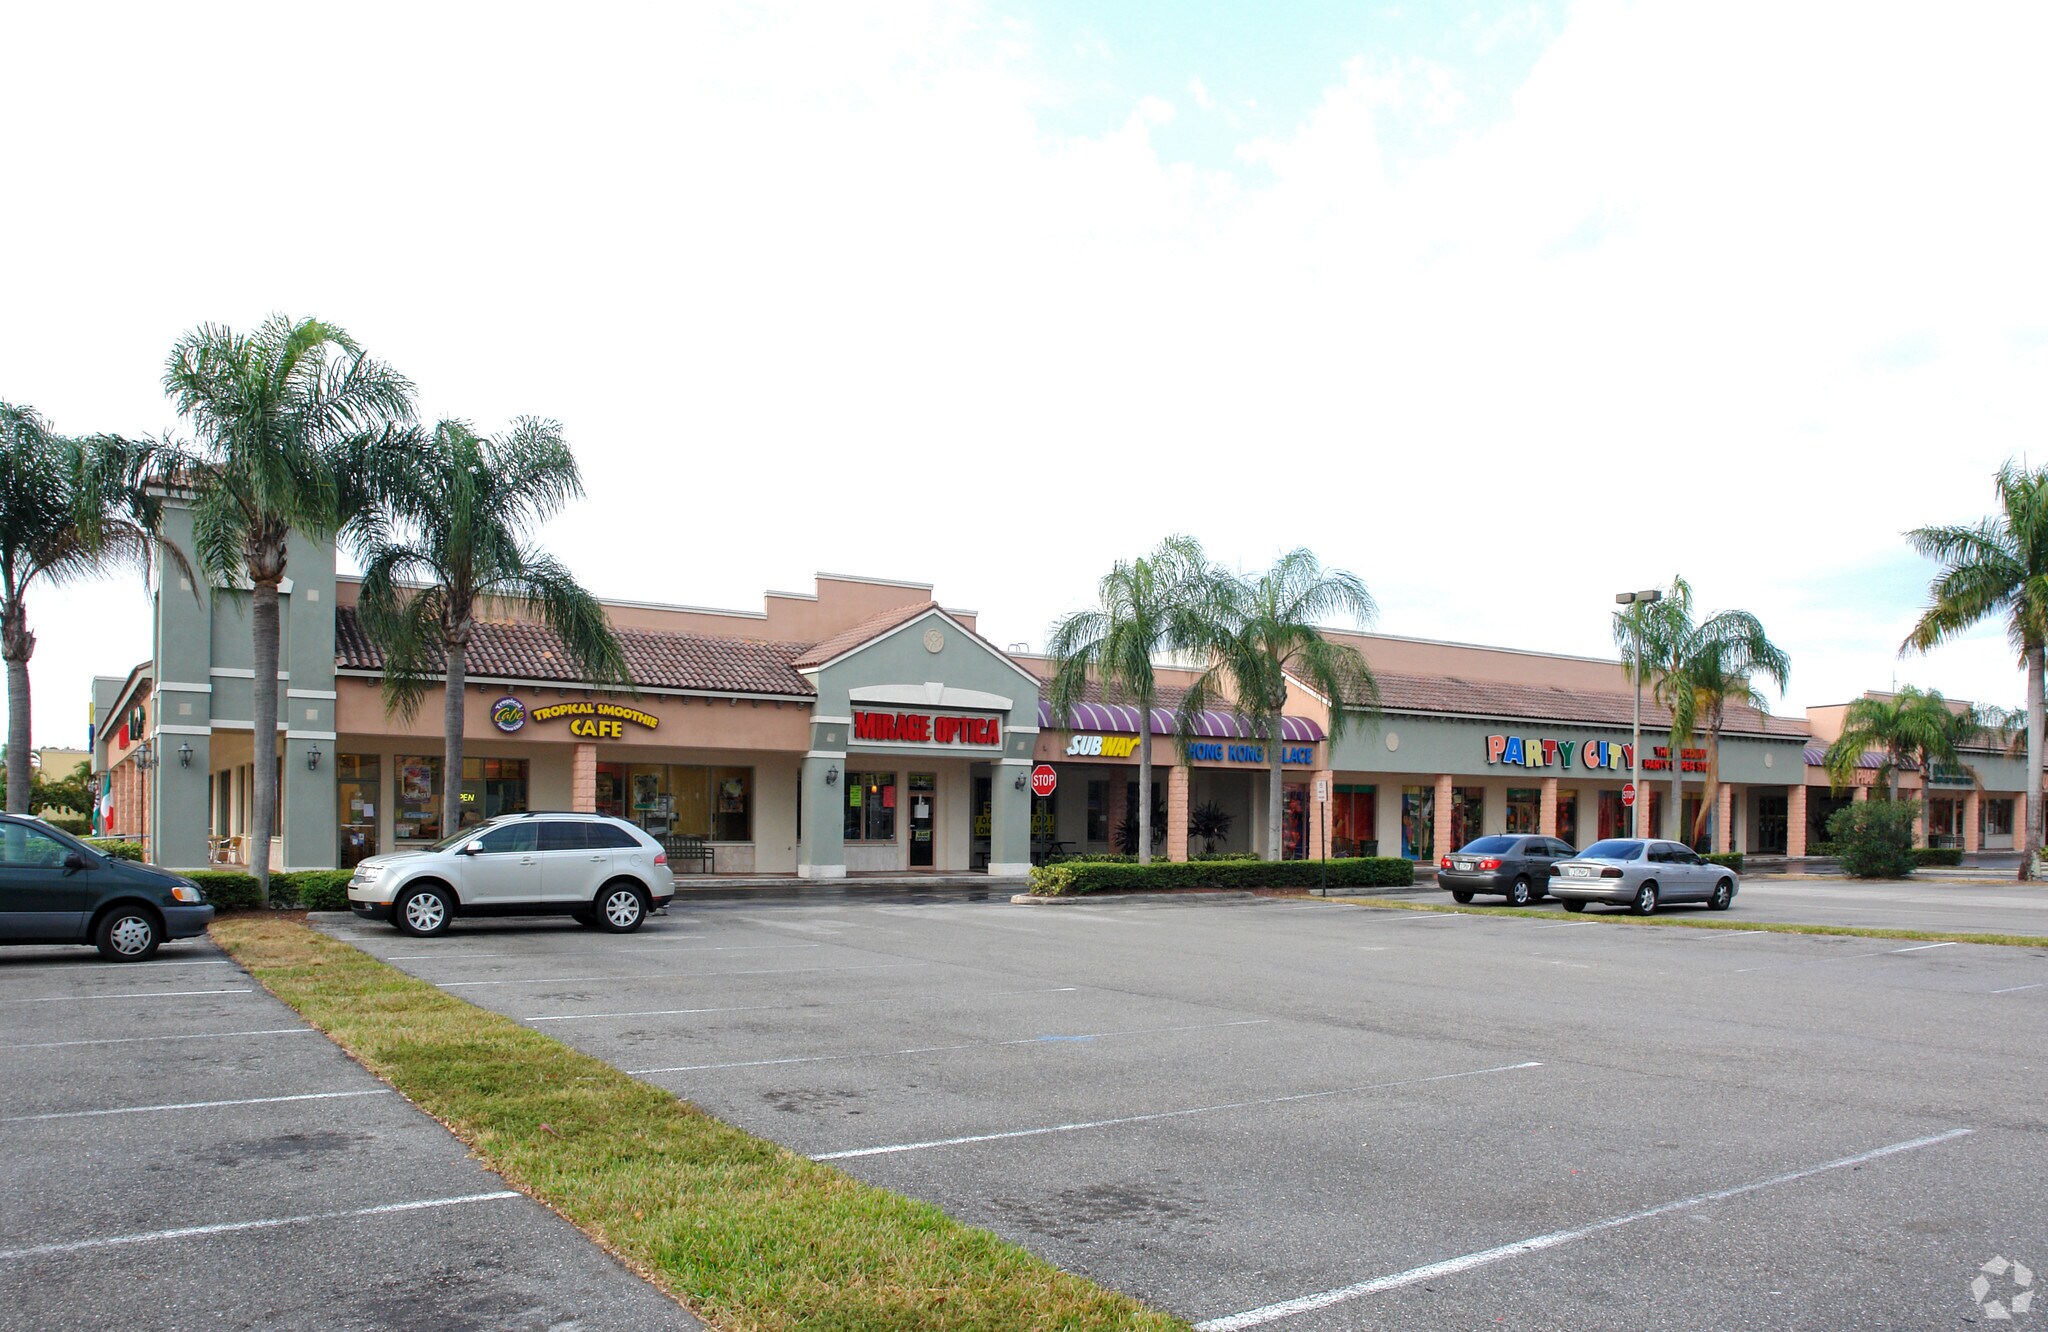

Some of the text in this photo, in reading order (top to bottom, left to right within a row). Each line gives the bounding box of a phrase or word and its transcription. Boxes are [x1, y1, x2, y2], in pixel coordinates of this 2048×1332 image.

[533, 703, 659, 728] TROPICAL SMOOTHIE
[570, 719, 623, 738] CAFE
[854, 711, 1000, 745] MIRAGE OPTICA
[1066, 735, 1140, 757] SUBWAY
[1187, 742, 1223, 761] HONG
[1228, 744, 1264, 763] KONG
[1487, 735, 1634, 769] PARTY CITY
[1033, 774, 1055, 787] STOP
[459, 793, 475, 802] PEN
[1623, 790, 1634, 799] STOP
